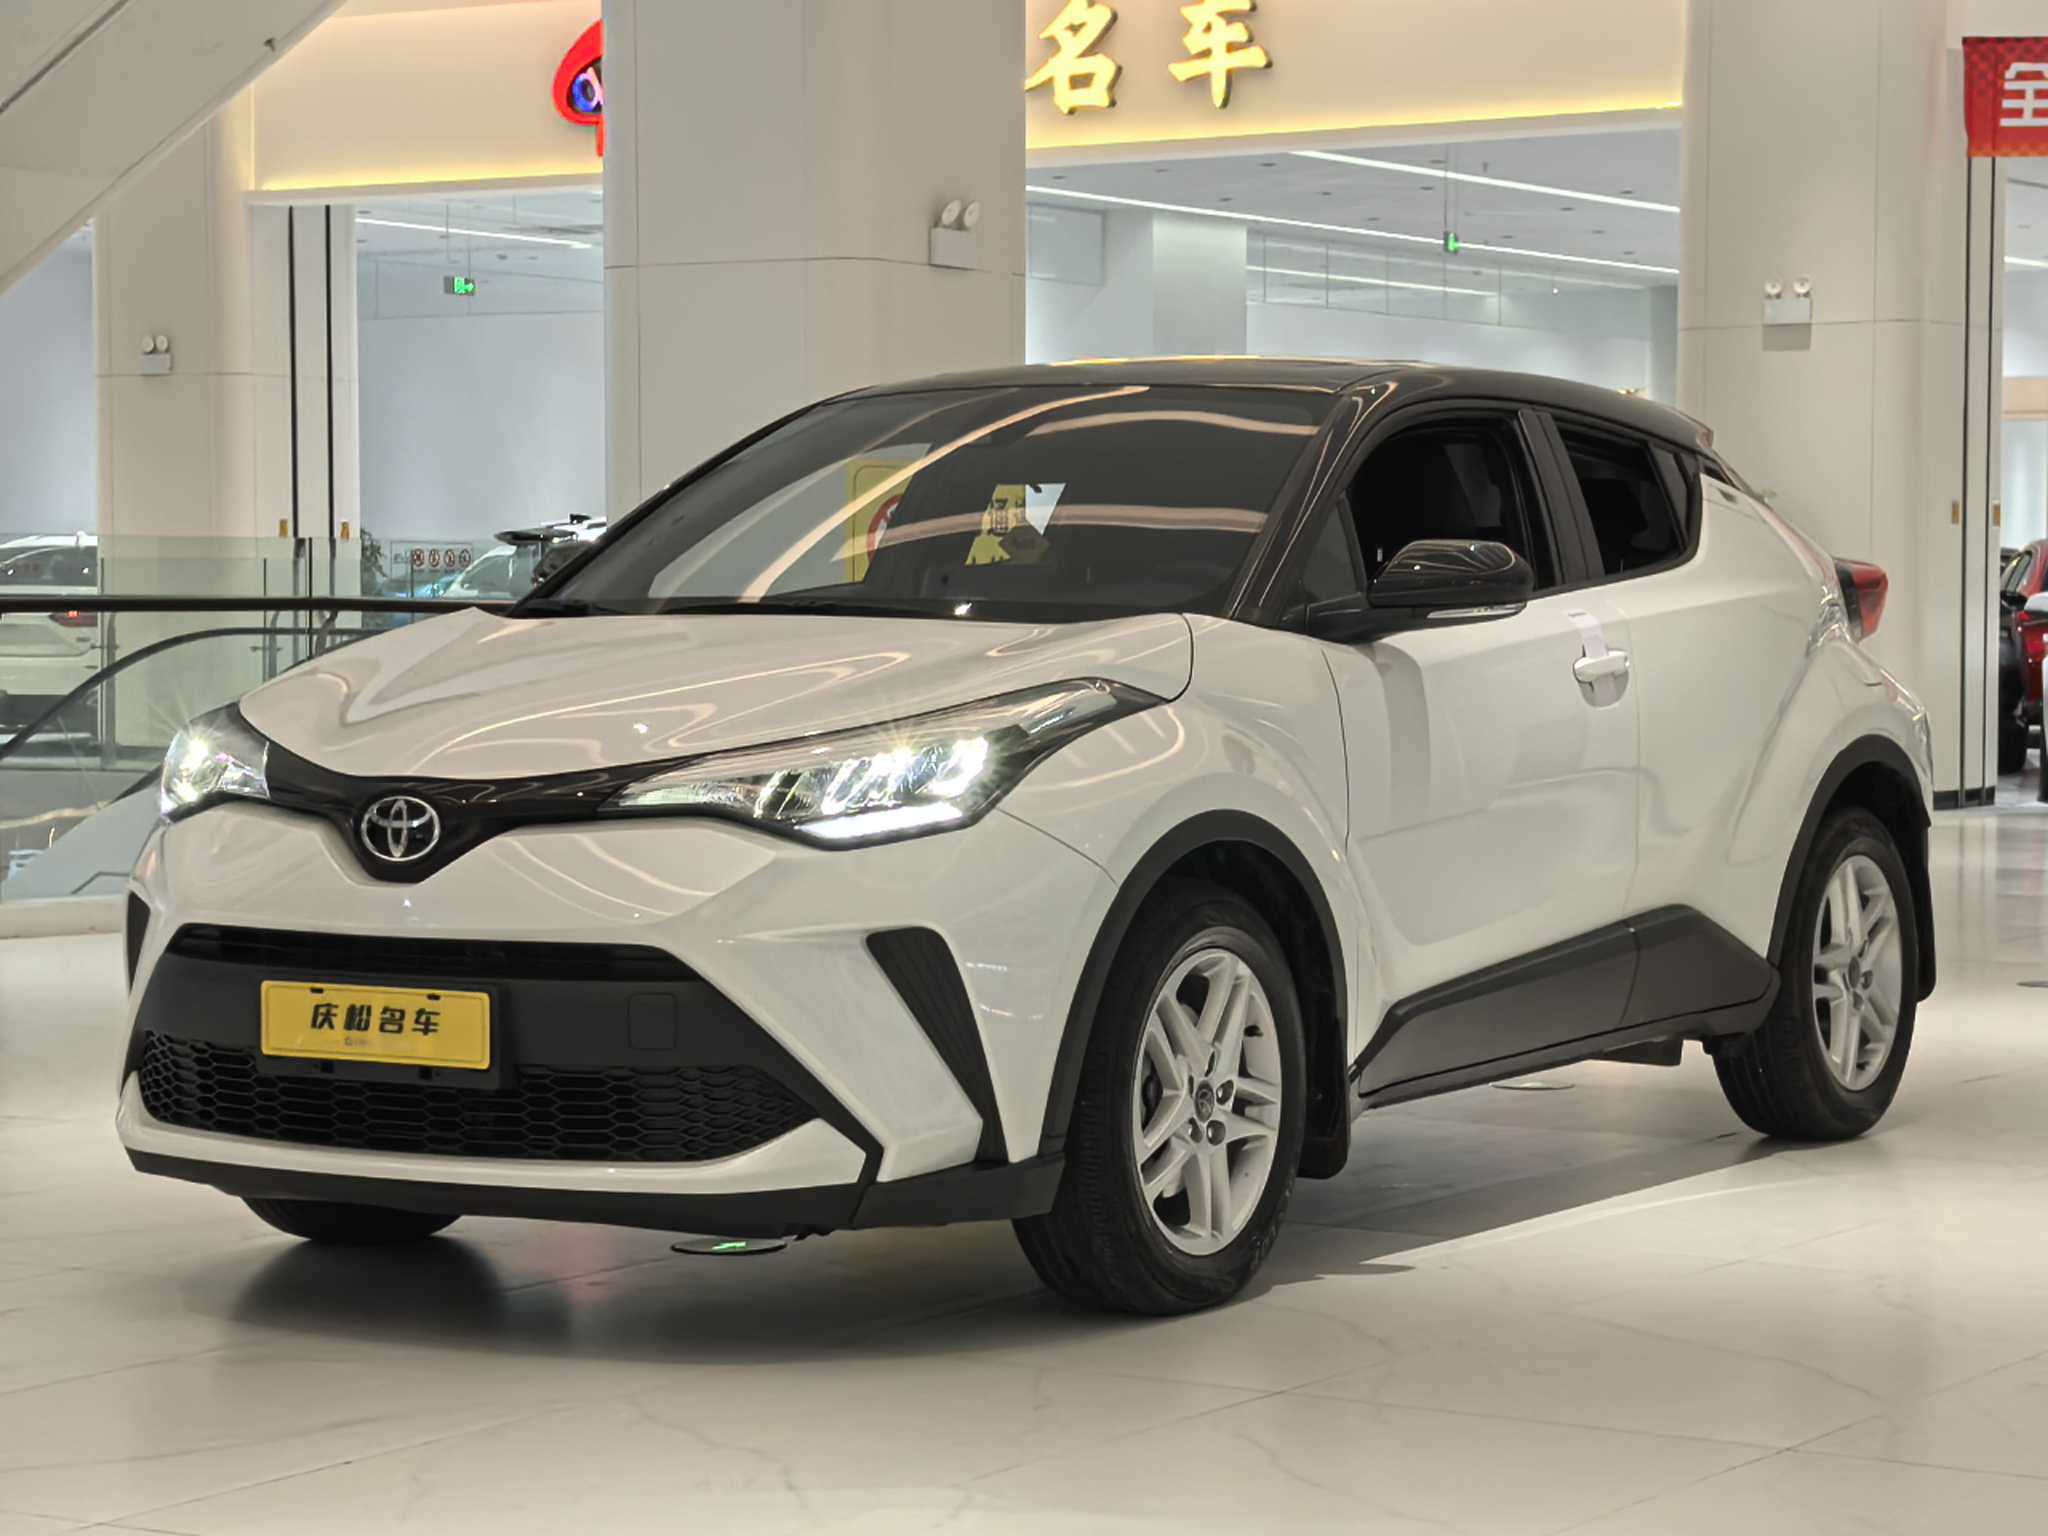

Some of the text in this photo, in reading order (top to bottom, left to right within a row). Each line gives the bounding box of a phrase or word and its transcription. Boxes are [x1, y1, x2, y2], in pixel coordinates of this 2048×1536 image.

[1025, 0, 1271, 114] 名车
[2000, 62, 2048, 127] 全
[310, 1003, 441, 1036] 庆松名车
